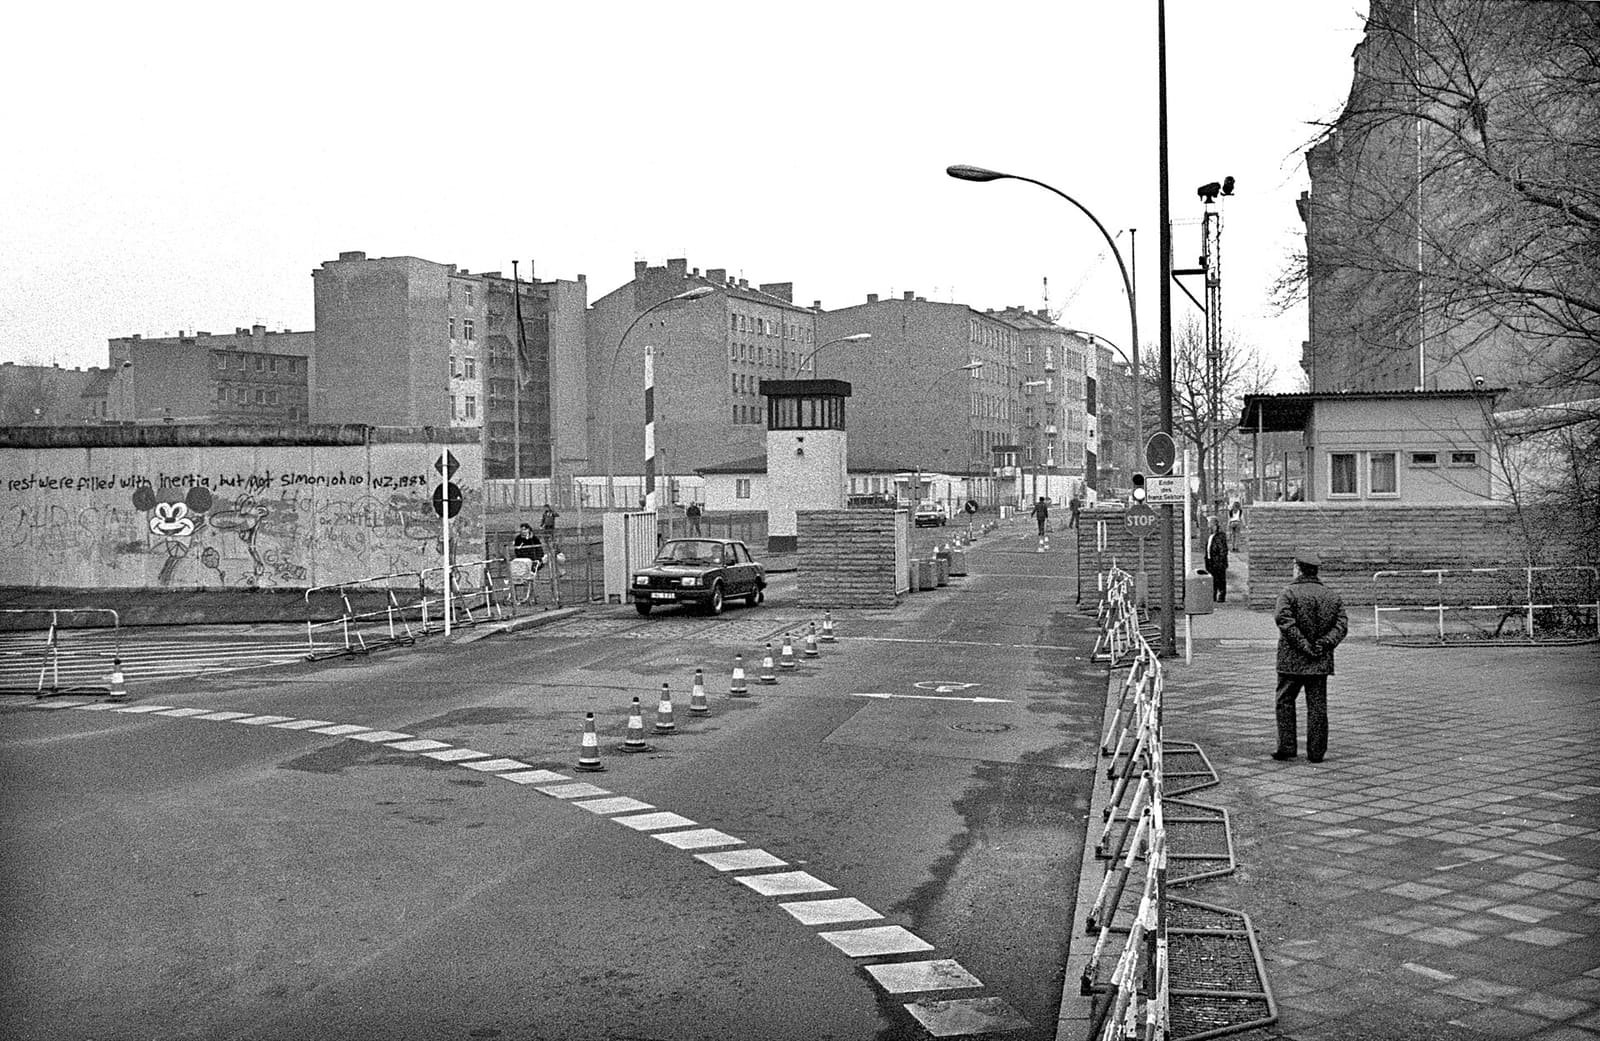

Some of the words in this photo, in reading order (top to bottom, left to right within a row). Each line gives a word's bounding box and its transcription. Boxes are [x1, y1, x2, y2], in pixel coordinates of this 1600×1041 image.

[8, 473, 37, 491] rest
[39, 475, 74, 490] were
[77, 473, 116, 491] filled
[120, 474, 153, 488] with
[220, 473, 244, 487] but
[1126, 514, 1156, 527] STOP
